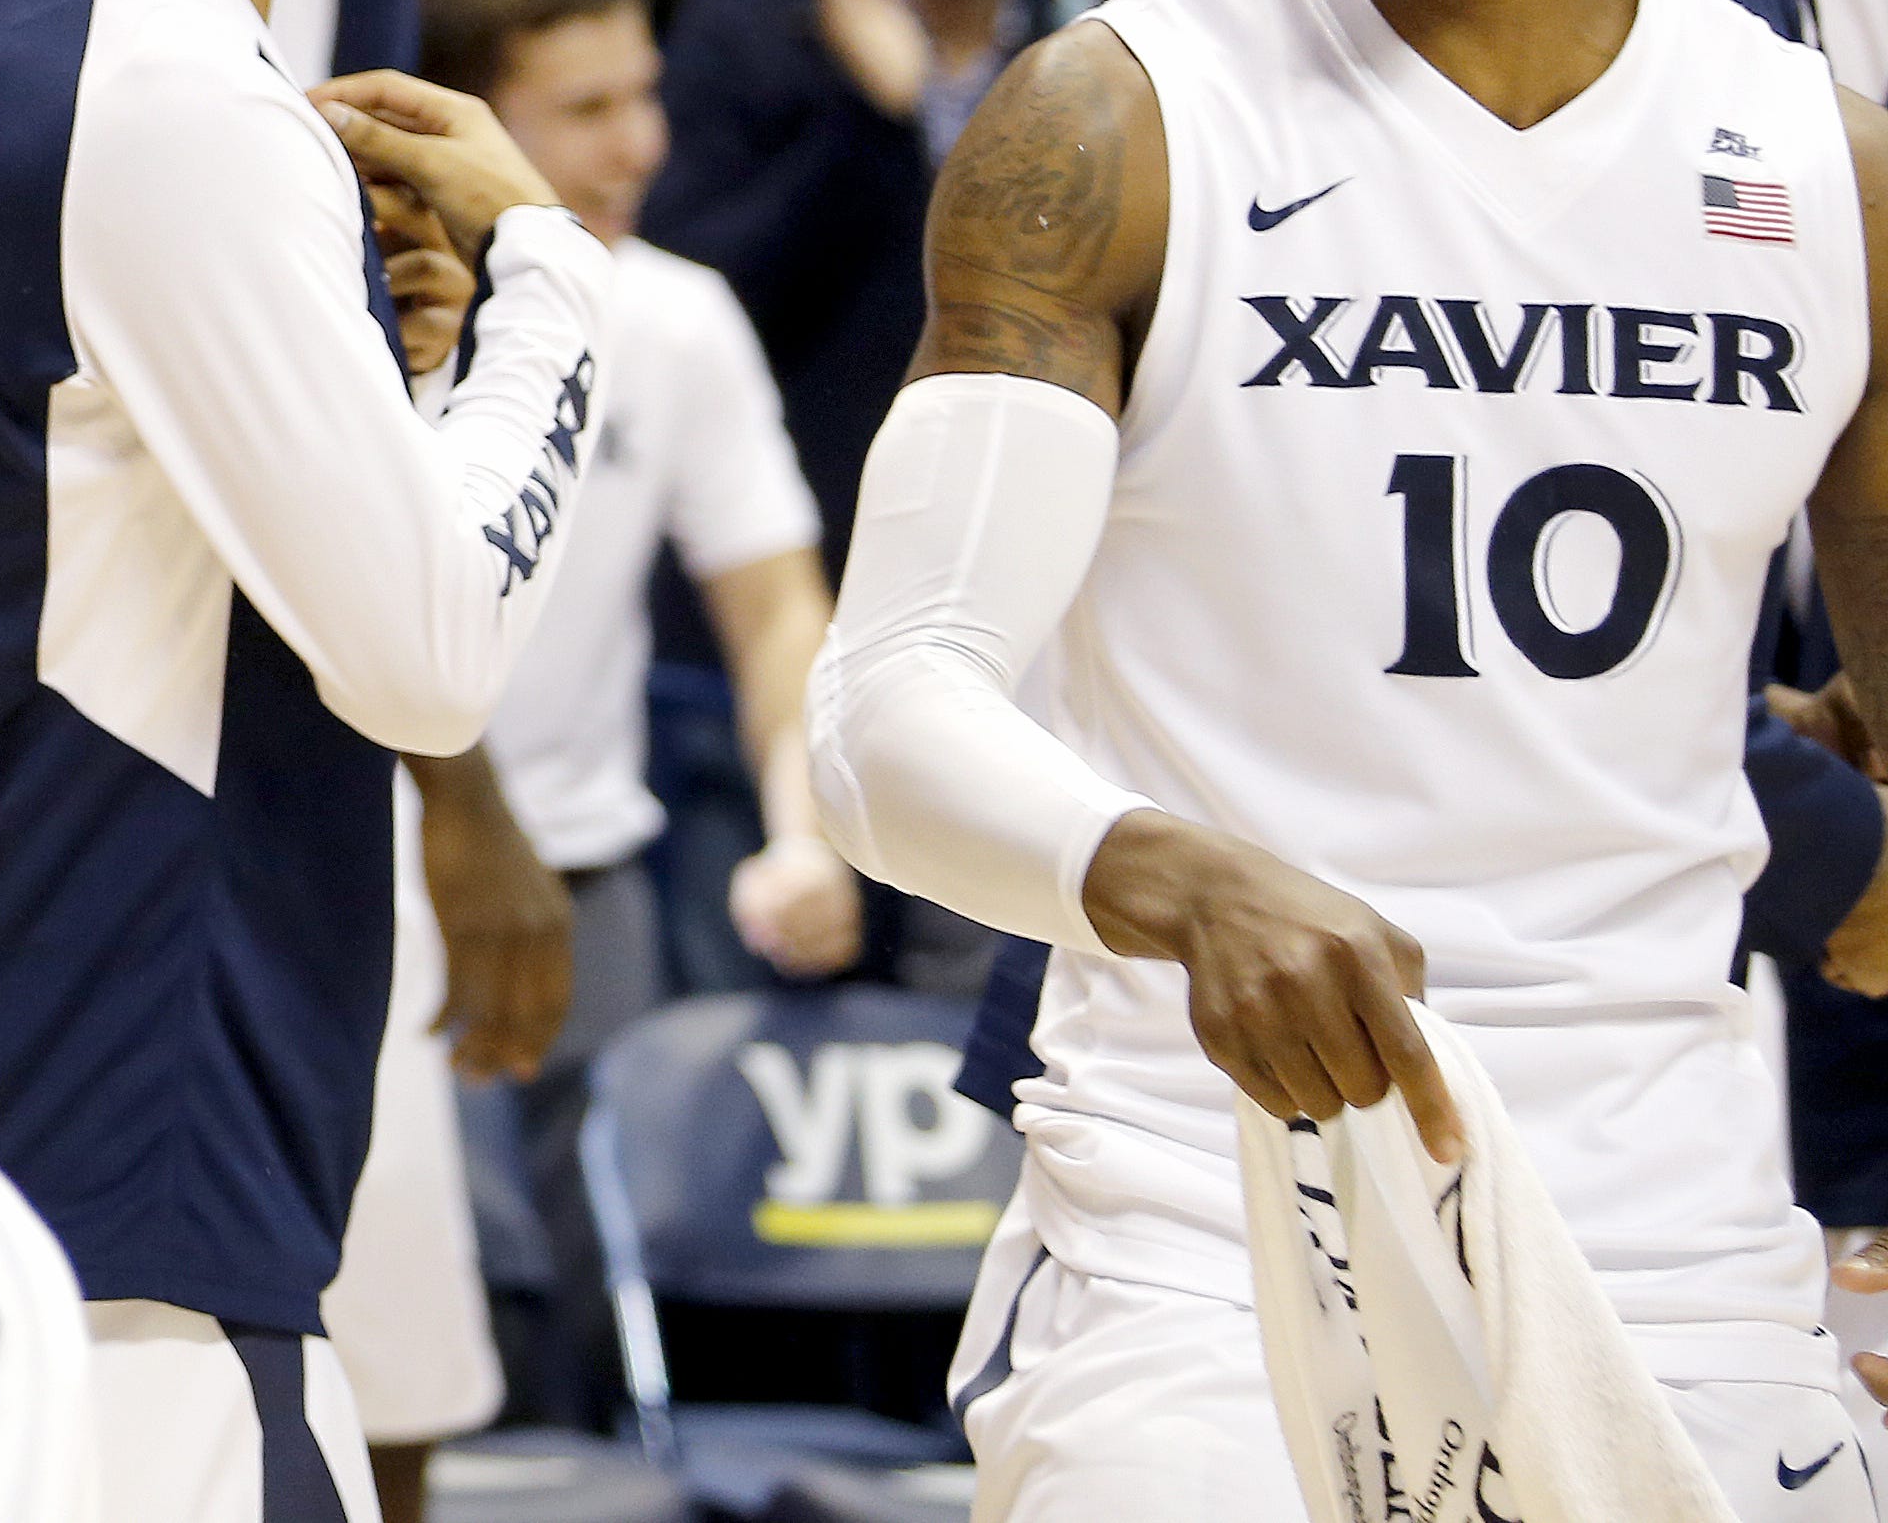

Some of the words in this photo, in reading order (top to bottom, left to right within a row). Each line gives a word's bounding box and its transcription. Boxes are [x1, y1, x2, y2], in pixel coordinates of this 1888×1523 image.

[1238, 294, 1809, 415] XAVIER
[1383, 451, 1685, 681] 10
[736, 1040, 994, 1210] yp
